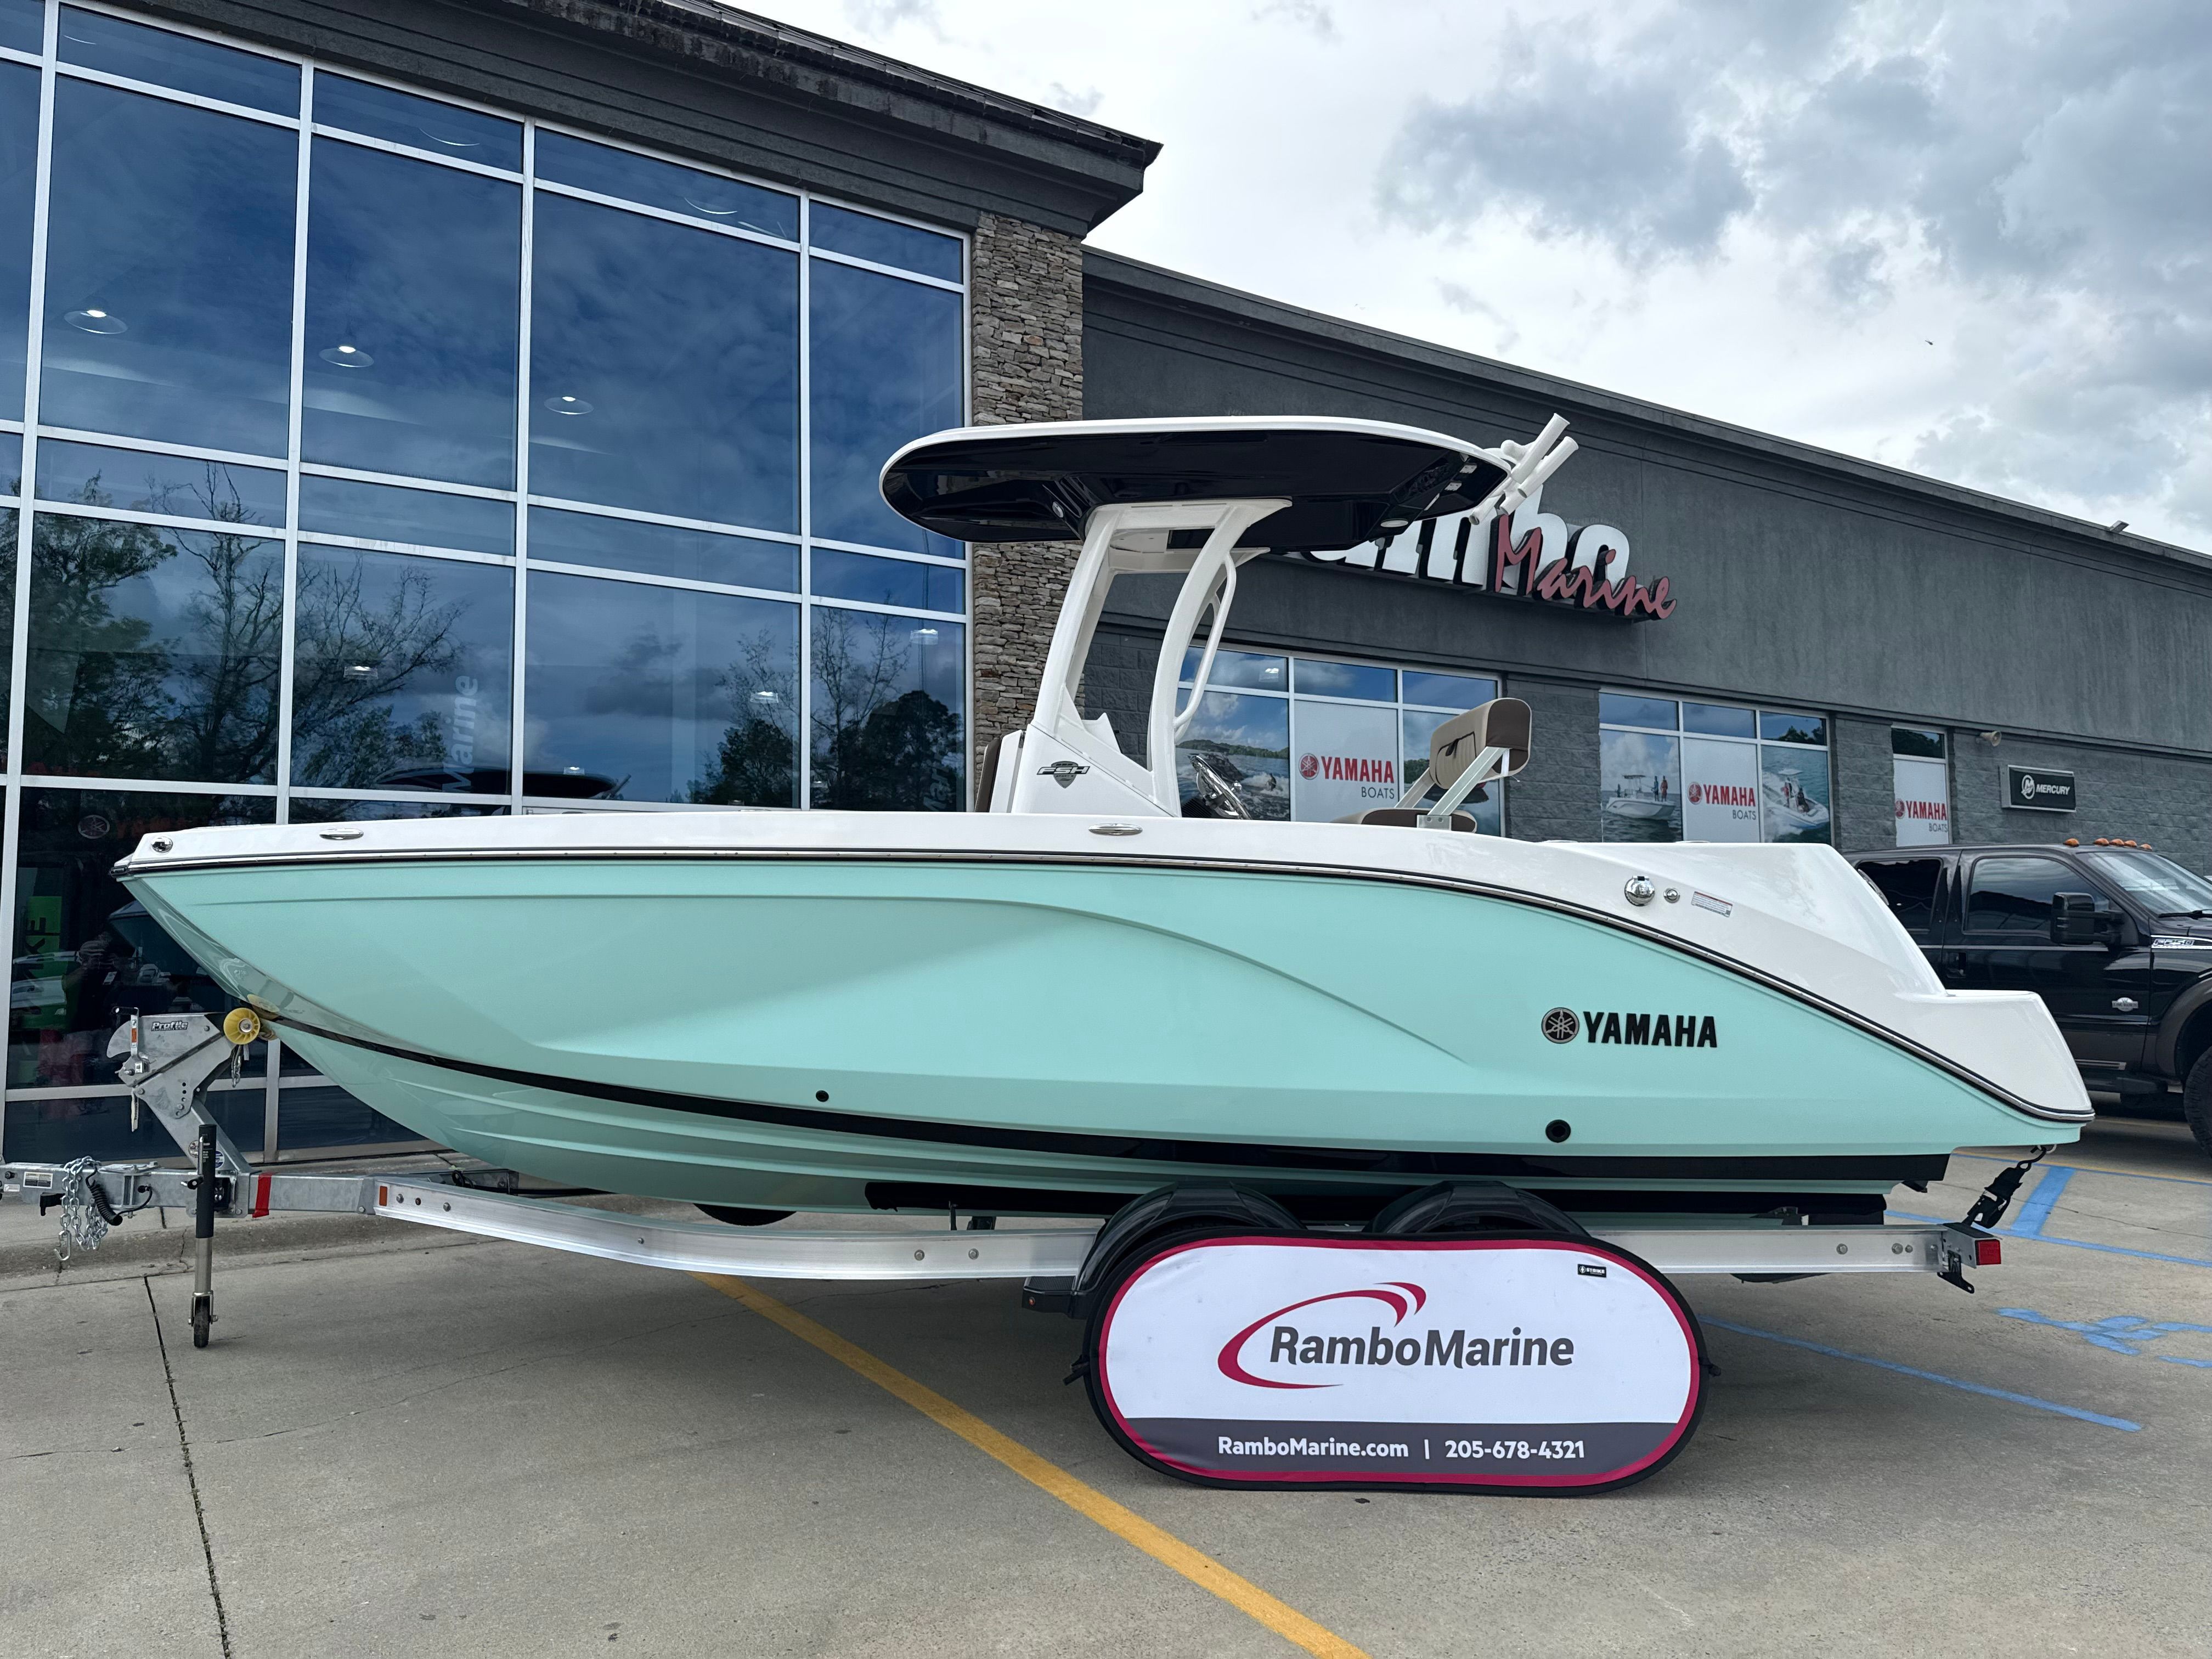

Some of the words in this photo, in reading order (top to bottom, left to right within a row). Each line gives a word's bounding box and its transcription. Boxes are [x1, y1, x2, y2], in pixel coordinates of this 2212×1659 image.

[1492, 514, 1677, 620] Marine
[1037, 766, 1090, 775] FSH
[1321, 756, 1395, 783] YAMAHA
[1361, 787, 1395, 799] BOATS
[1703, 784, 1756, 807] YAMAHA
[2036, 784, 2070, 795] MERCURY
[1733, 809, 1756, 820] BOATS
[1906, 800, 1947, 821] YAMAHA
[1929, 823, 1948, 833] BOATS
[1583, 1011, 1718, 1048] YAMAHA
[1218, 1436, 1409, 1457] RamboMarine.com
[1445, 1440, 1584, 1459] 205-678-4321
